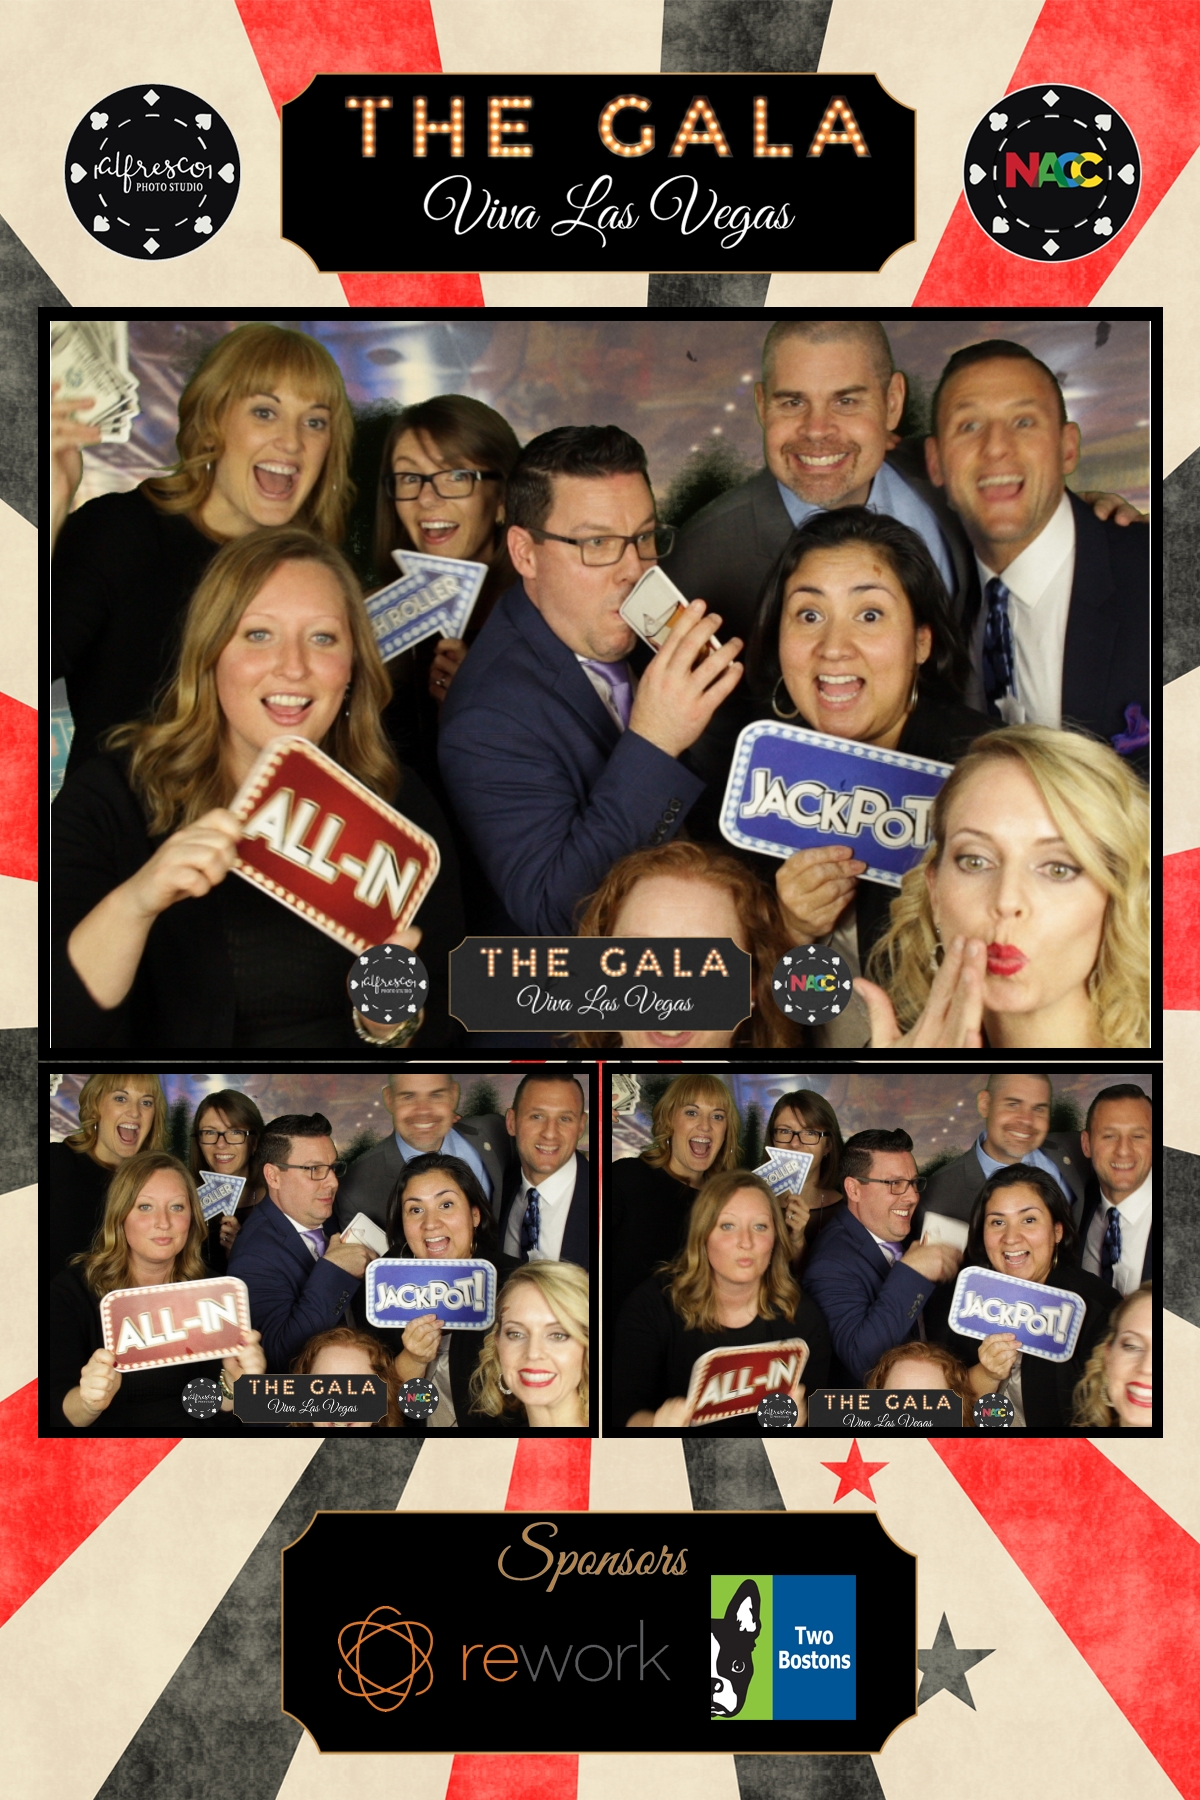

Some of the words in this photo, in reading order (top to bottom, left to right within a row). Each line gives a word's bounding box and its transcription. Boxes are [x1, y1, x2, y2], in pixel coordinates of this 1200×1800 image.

[384, 574, 462, 629] ROLLER
[240, 786, 421, 920] ALL-IN
[200, 1183, 233, 1209] OLLER
[115, 1293, 238, 1355] ALL-IN
[696, 1353, 798, 1411] ALL-IN
